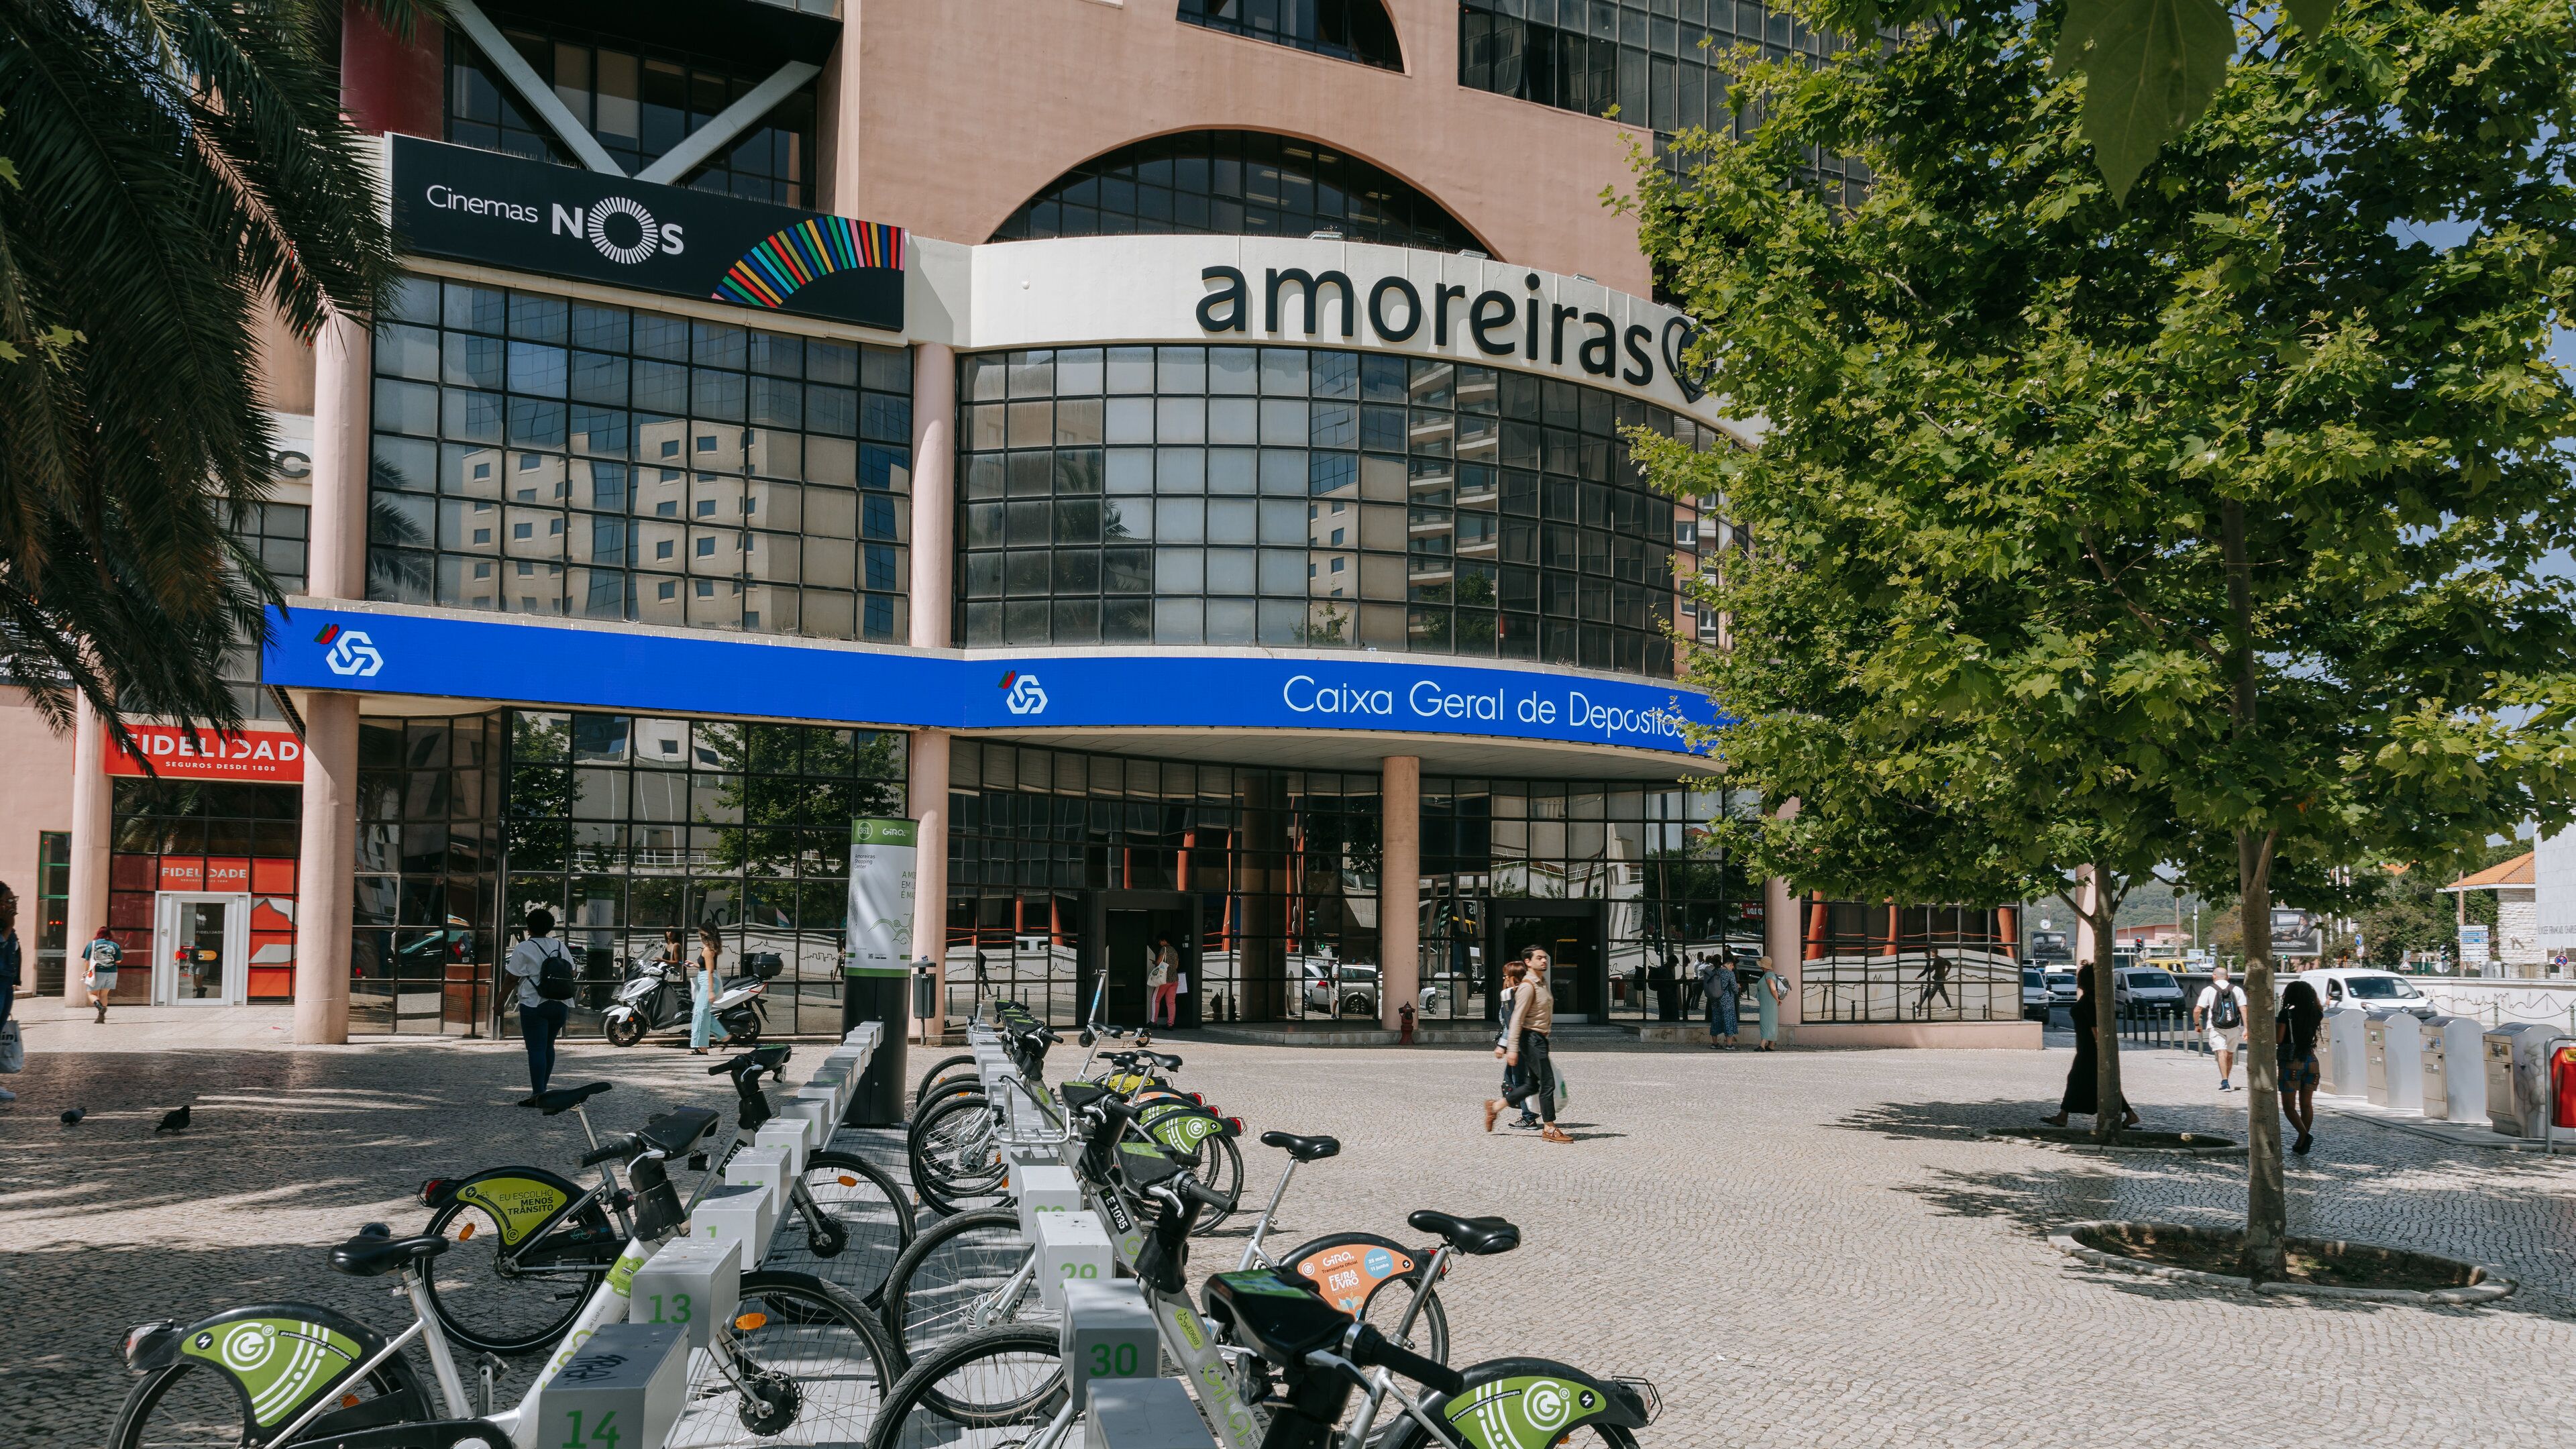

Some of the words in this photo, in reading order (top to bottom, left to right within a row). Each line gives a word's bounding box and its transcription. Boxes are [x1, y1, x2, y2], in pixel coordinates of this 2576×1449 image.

[427, 184, 539, 223] Cinemas
[551, 197, 684, 264] NOS
[1195, 265, 1654, 386] amoreiras
[1283, 675, 1393, 714] Caixa
[1409, 680, 1503, 720] Geral
[1518, 691, 1556, 724] de
[165, 761, 212, 769] SEGUROS
[513, 1189, 553, 1199] ESCOLHO
[521, 1197, 553, 1207] MENOS
[507, 1204, 553, 1216] TRÂNSITO
[1322, 1265, 1345, 1274] Transporte
[1344, 1260, 1358, 1268] Oficial
[1375, 1263, 1389, 1271] junho
[648, 1293, 692, 1324] 13
[1089, 1343, 1138, 1377] 30
[562, 1410, 621, 1449] 14
